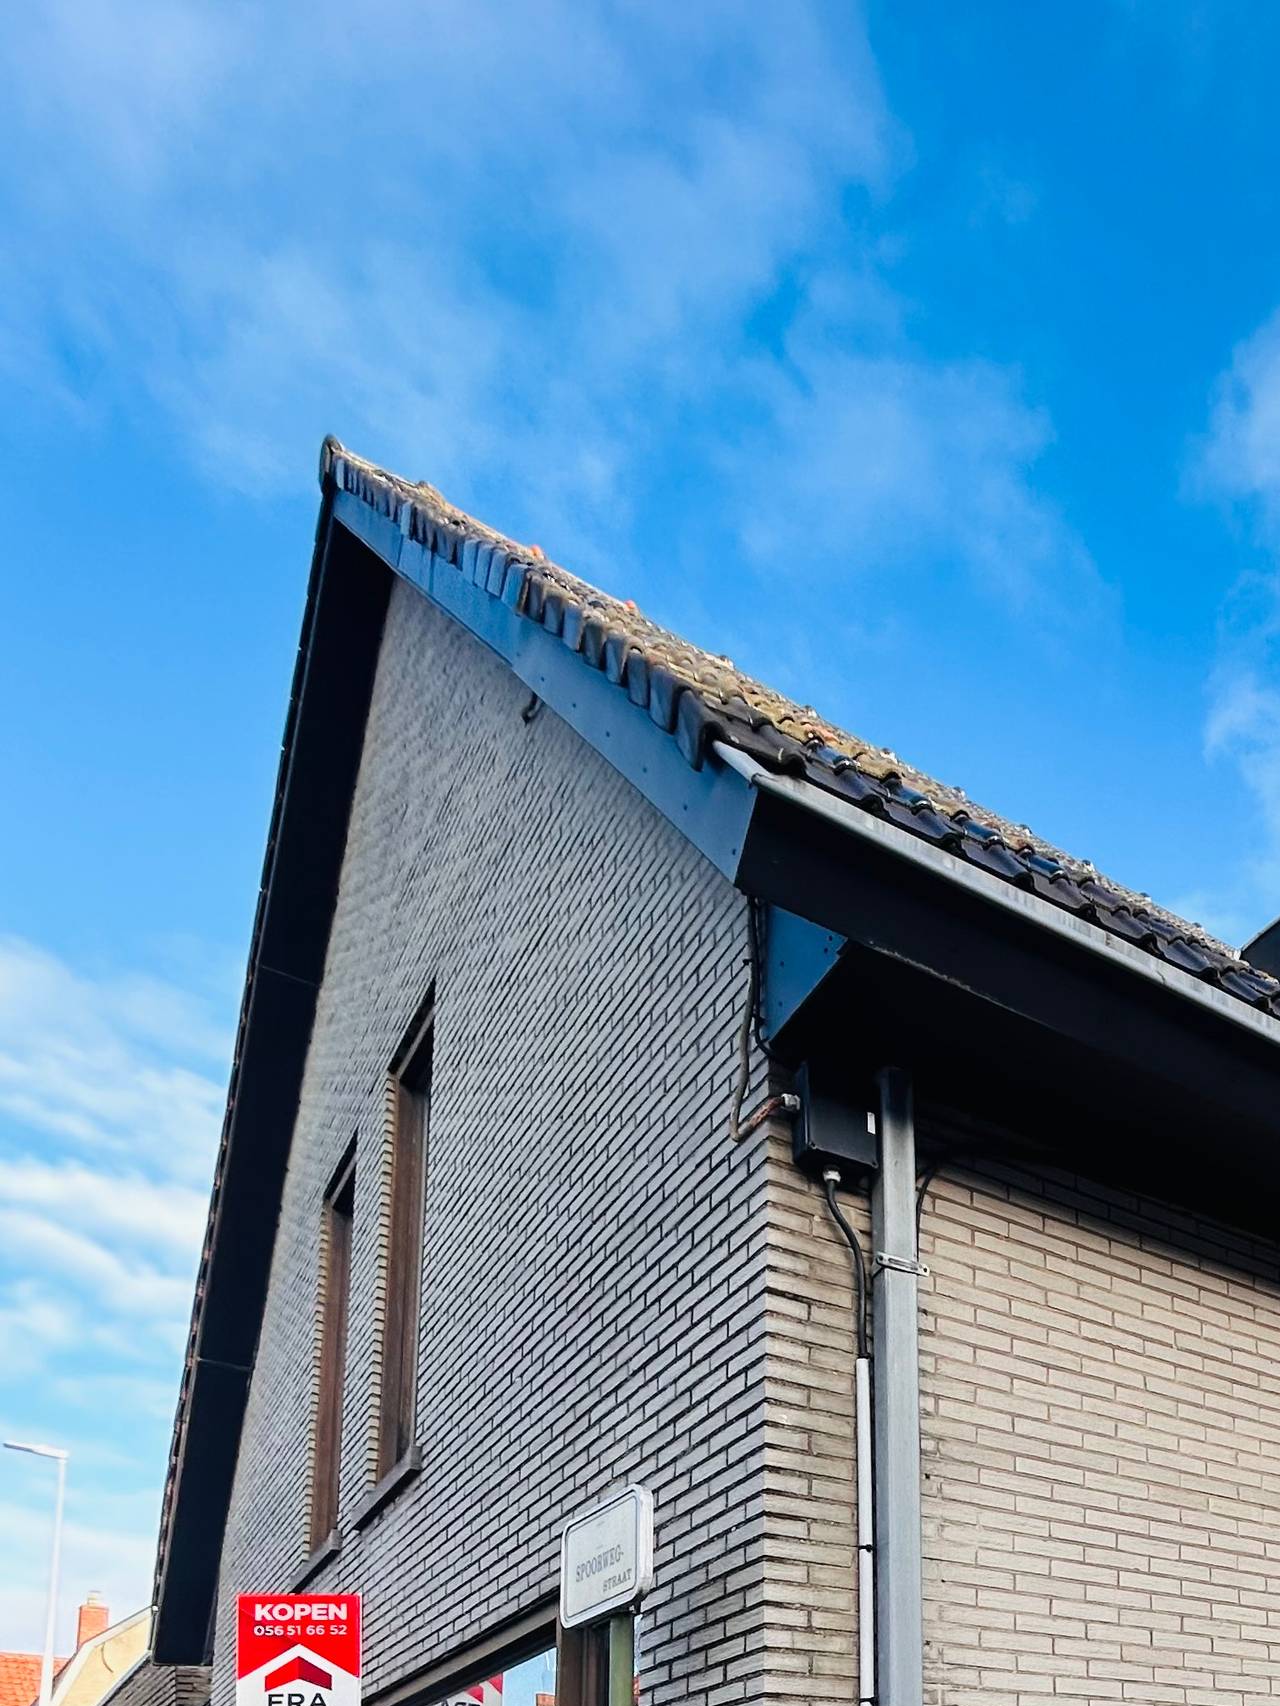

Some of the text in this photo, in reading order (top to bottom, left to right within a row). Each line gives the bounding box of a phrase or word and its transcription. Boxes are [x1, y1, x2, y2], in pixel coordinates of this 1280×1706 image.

[602, 1568, 633, 1593] STRAAT
[254, 1603, 348, 1622] KOPEN
[253, 1624, 348, 1637] 056 51 66 52
